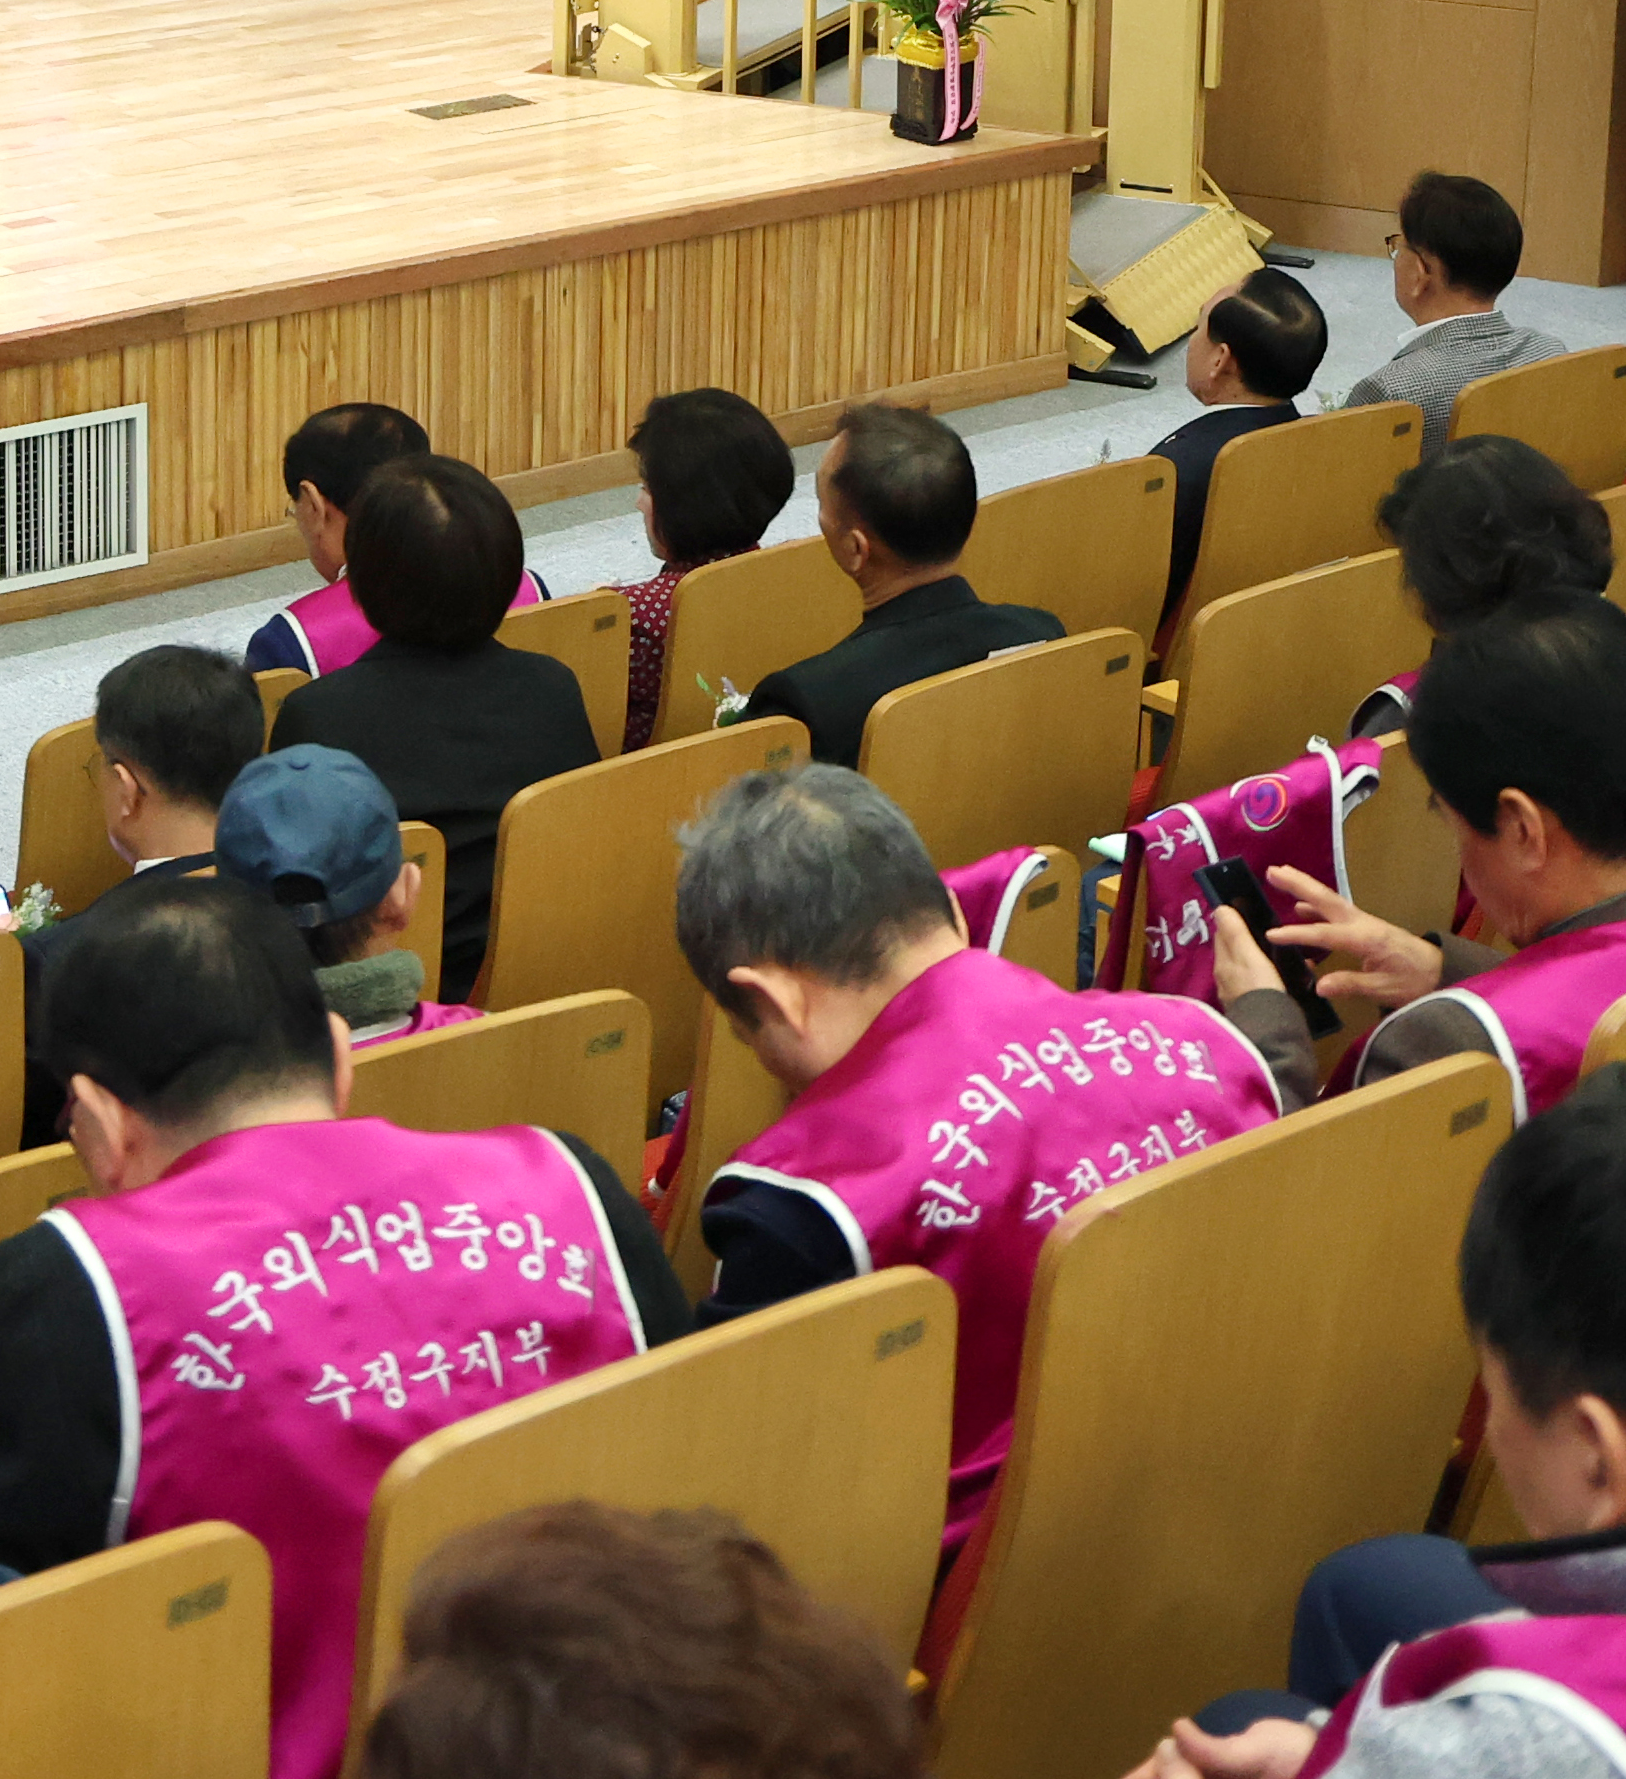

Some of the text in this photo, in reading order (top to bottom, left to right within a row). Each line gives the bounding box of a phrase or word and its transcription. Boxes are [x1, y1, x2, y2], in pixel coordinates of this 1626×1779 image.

[916, 1017, 1223, 1229] 한국외식업중앙회
[171, 1200, 597, 1392] 한국외식업중앙회
[304, 1320, 553, 1420] 수정구지부
